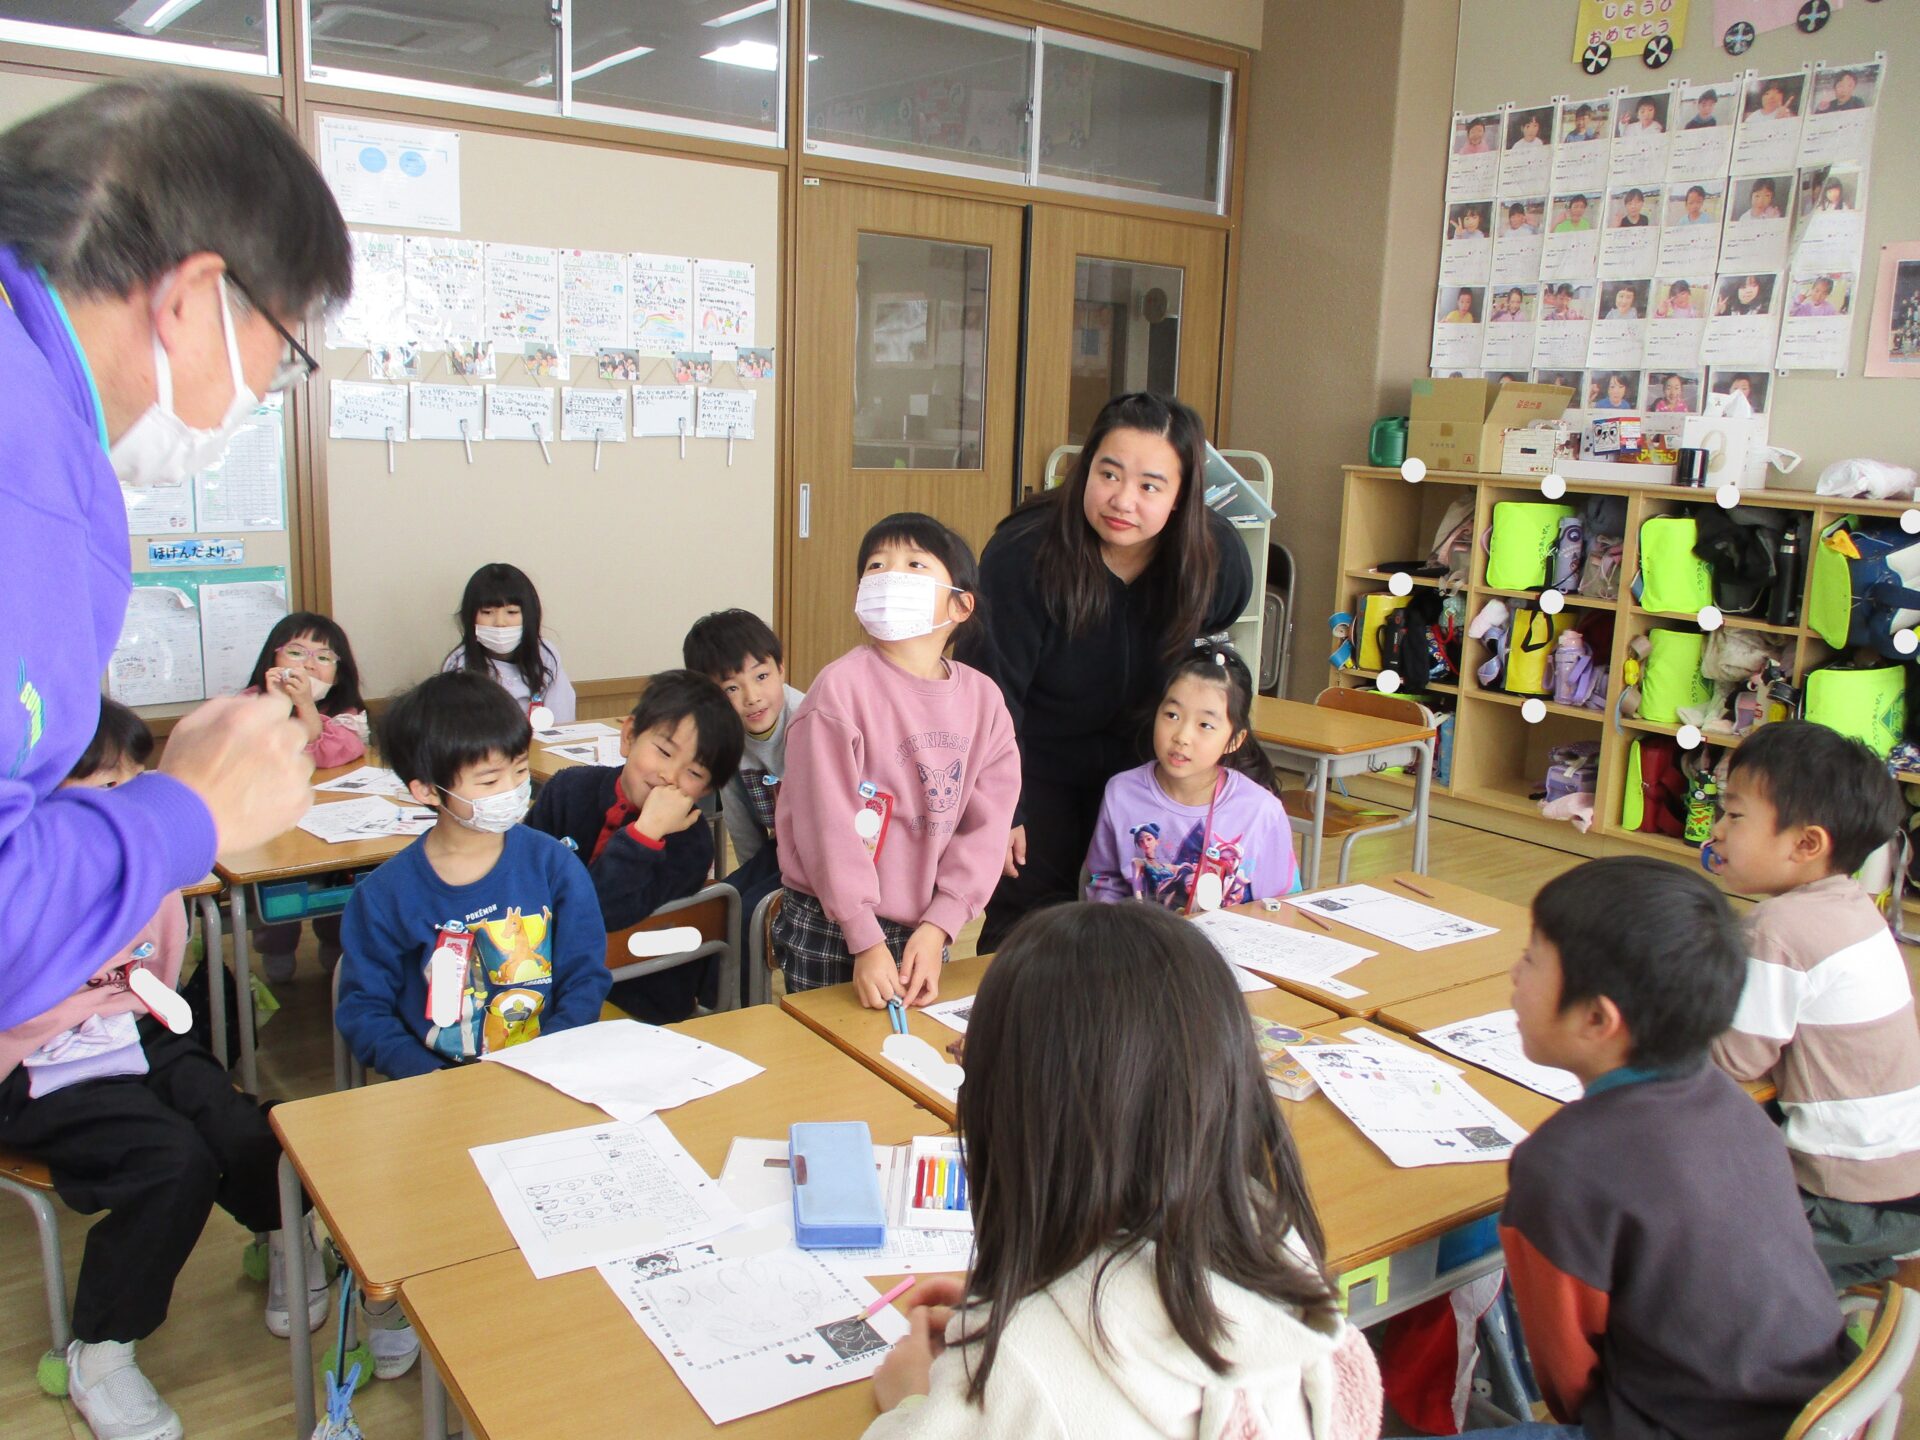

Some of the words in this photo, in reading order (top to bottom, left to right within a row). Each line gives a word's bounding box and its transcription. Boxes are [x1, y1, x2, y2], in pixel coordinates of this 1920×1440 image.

[1589, 19, 1670, 45] おめでとう
[153, 545, 226, 560] ほけんだより
[896, 732, 970, 767] CUTNESS
[465, 904, 498, 922] POKÉMON
